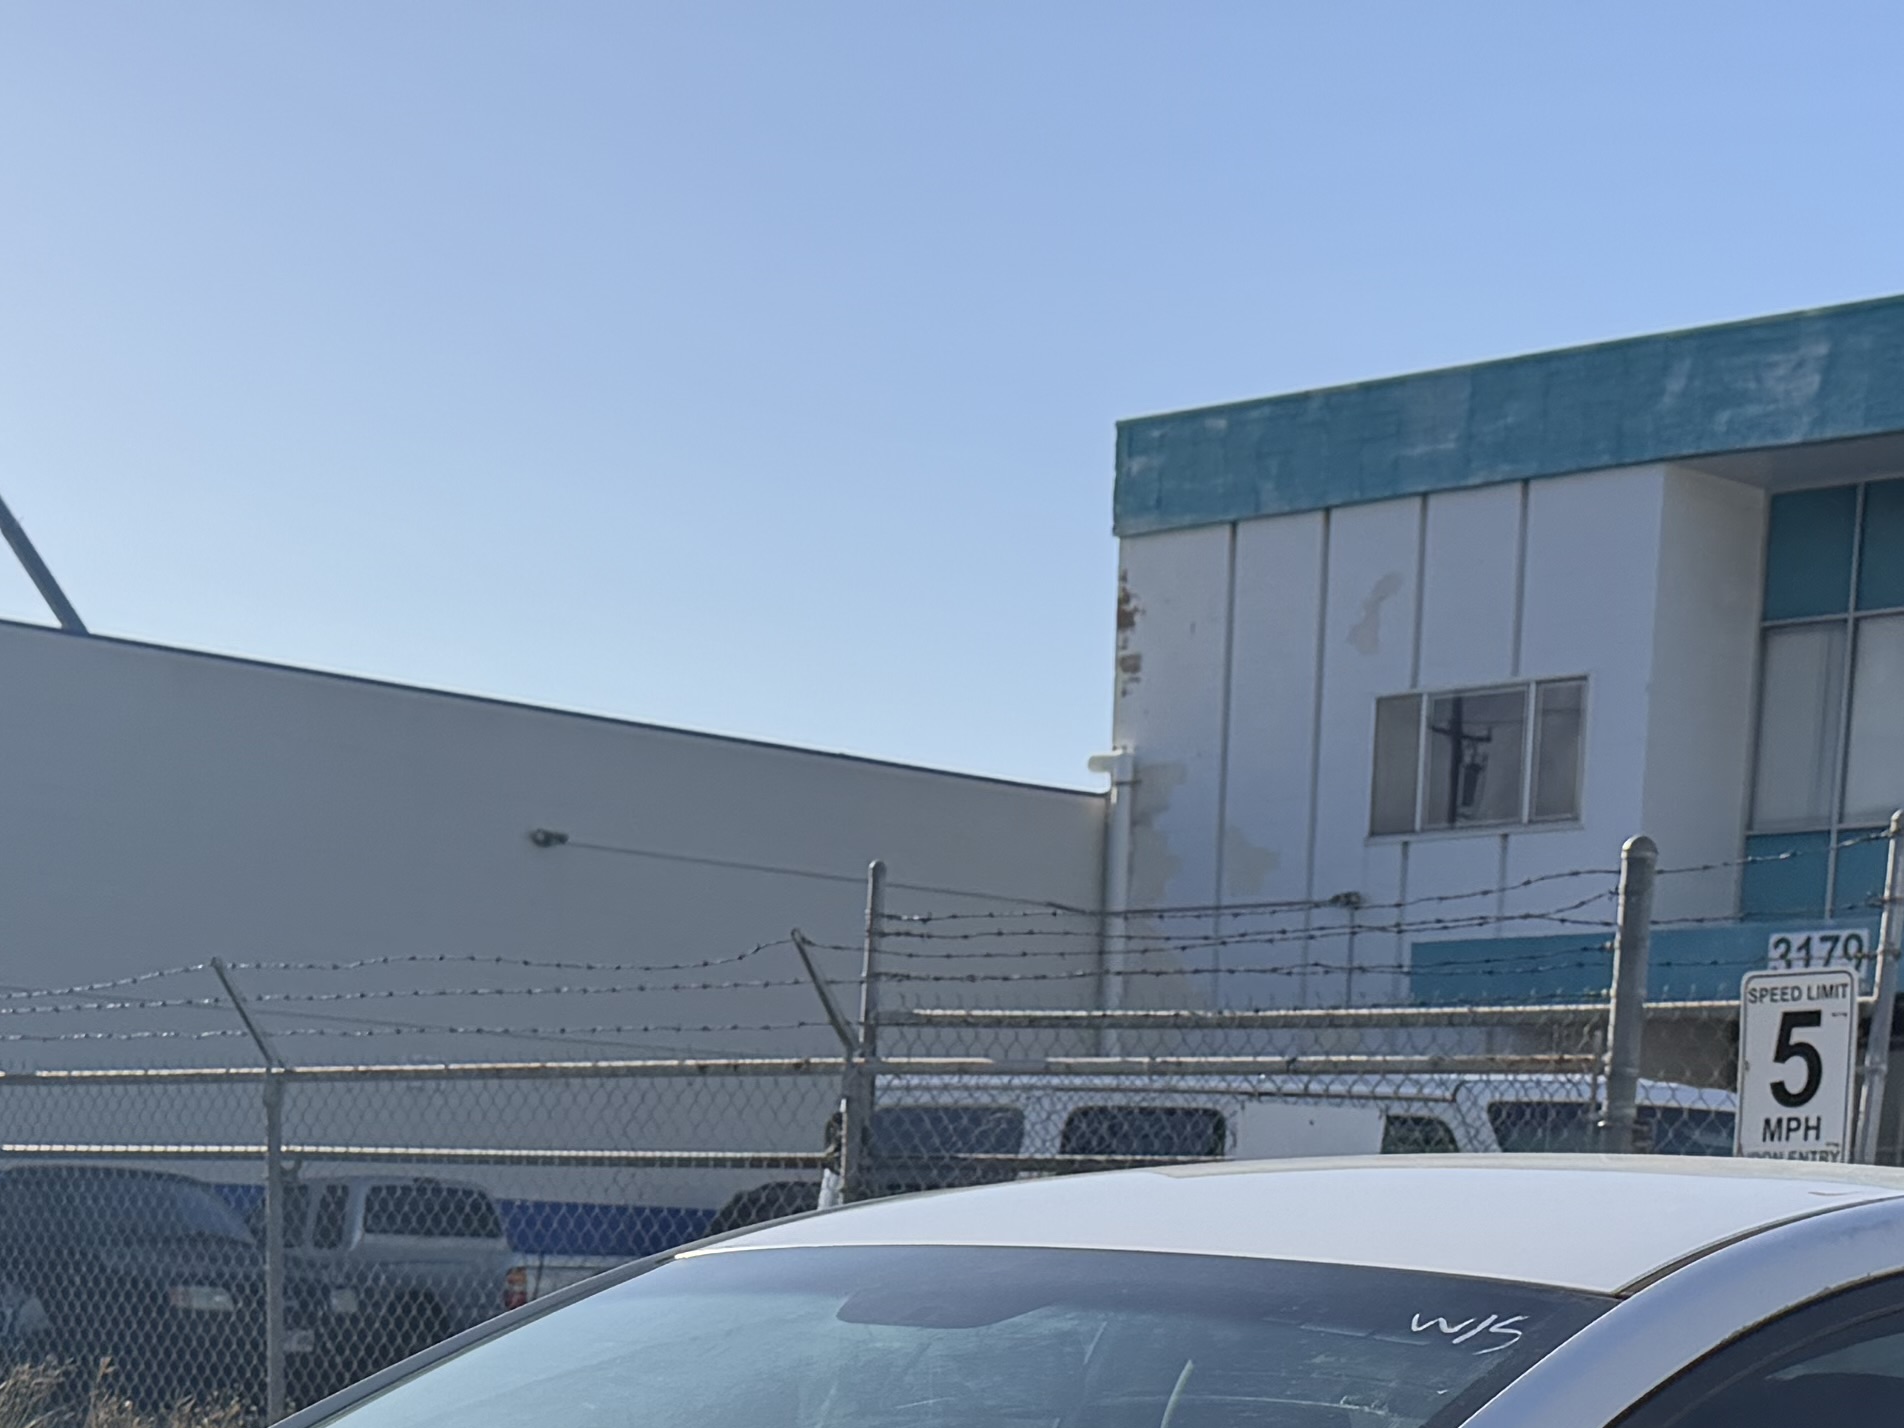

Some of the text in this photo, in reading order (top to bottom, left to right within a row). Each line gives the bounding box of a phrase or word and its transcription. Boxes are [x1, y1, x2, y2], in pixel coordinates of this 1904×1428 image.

[1748, 983, 1849, 1004] SPEED LIMIT
[1769, 1009, 1823, 1108] 5
[1762, 1116, 1821, 1142] MPH
